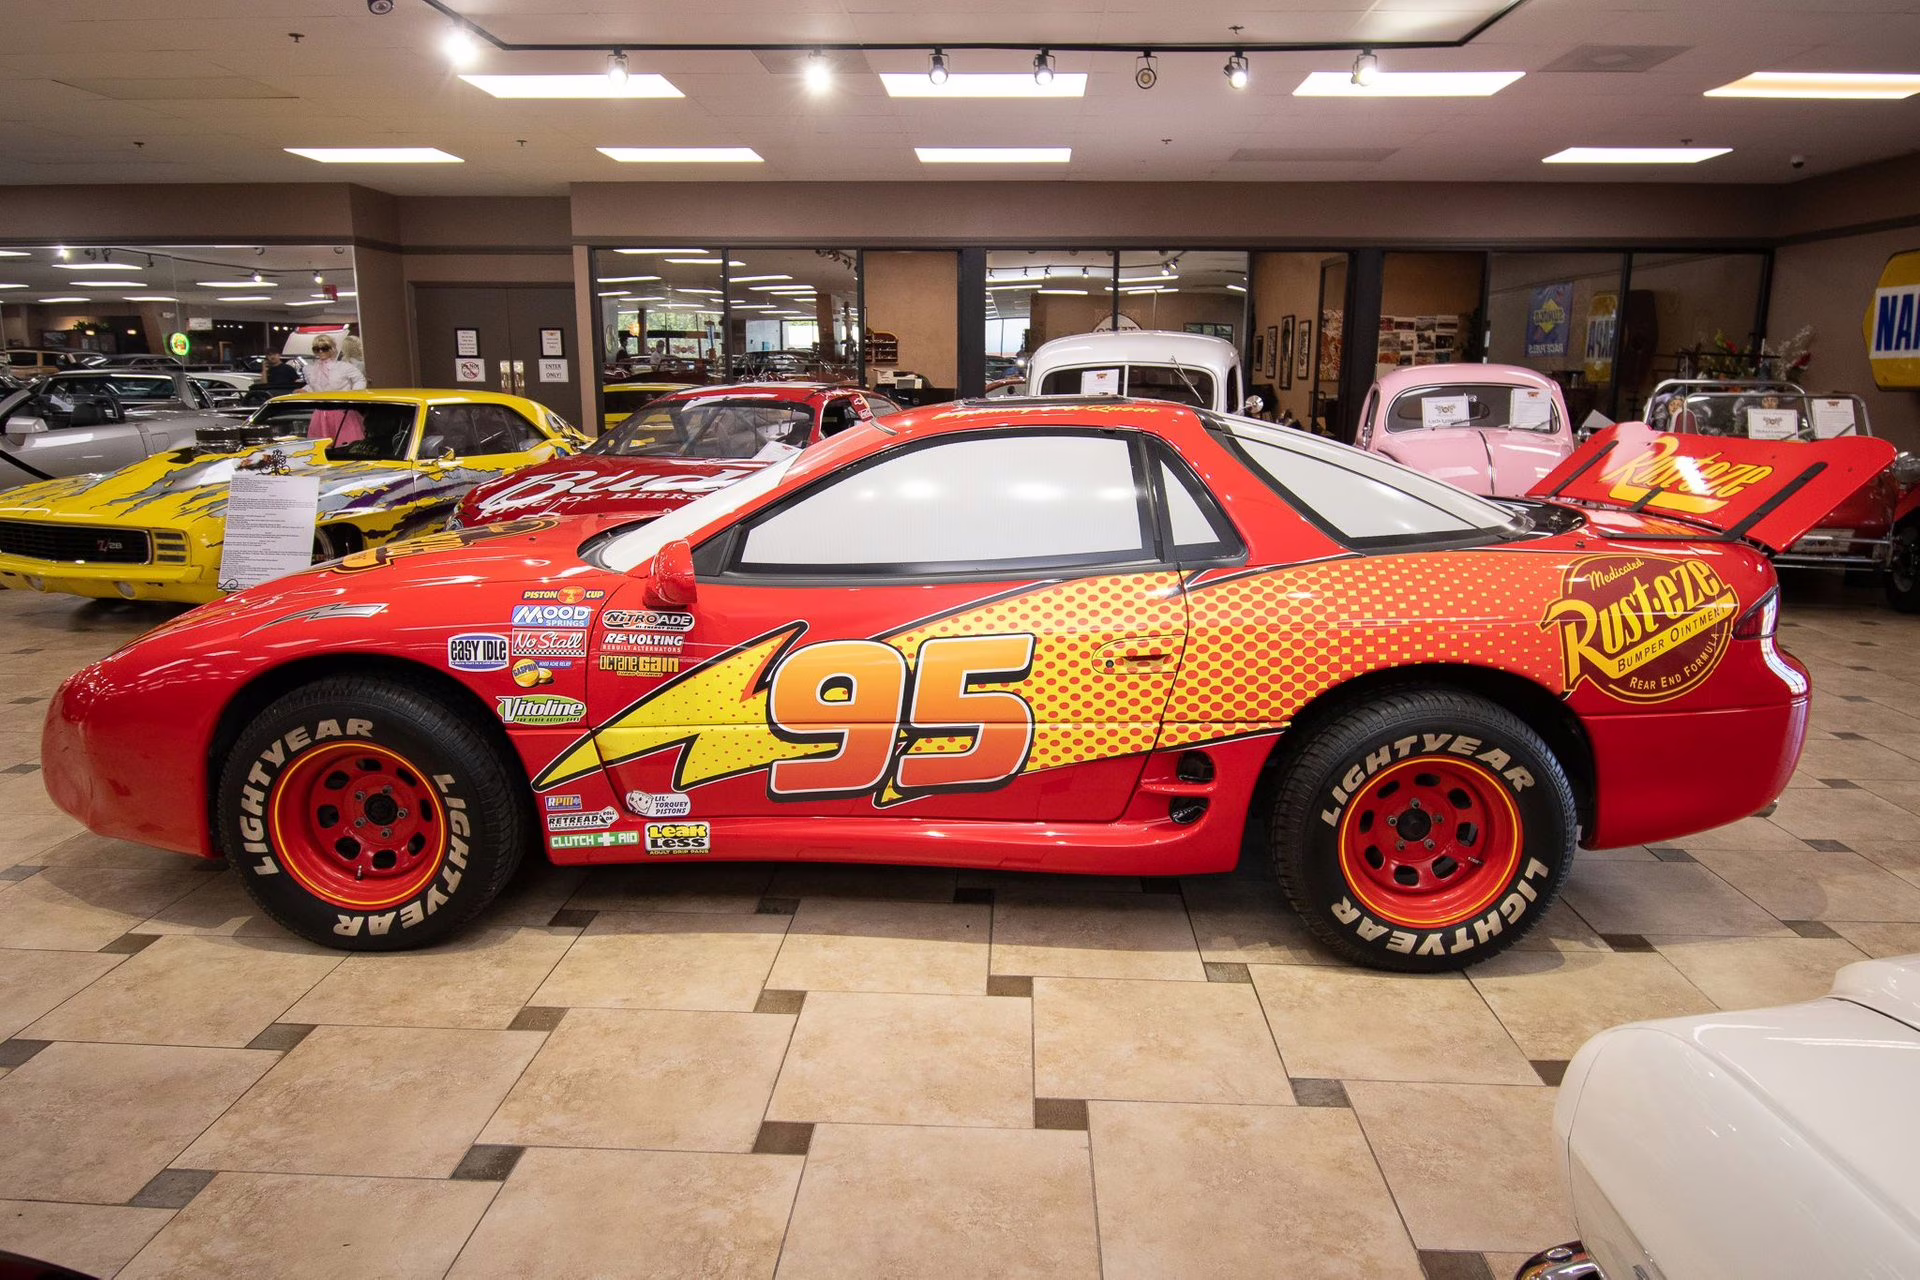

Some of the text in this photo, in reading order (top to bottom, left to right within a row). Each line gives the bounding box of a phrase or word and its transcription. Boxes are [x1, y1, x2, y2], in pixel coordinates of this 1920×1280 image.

[560, 494, 602, 502] OF
[1586, 557, 1645, 591] Medicated
[523, 591, 604, 599] PISTON CUP
[514, 606, 590, 623] MOOD
[513, 631, 583, 649] No Stall
[633, 645, 681, 653] ALTERNATORS
[1629, 676, 1657, 690] REAR
[1661, 674, 1682, 688] END
[502, 698, 584, 722] Vitoline
[766, 633, 1037, 803] 95
[1321, 733, 1536, 828] LIGHTYEAR
[239, 718, 375, 876] LIGHTYEAR
[655, 801, 689, 809] TORQUEY
[549, 815, 599, 825] RETREAD
[551, 832, 638, 848] CLUTCH AID
[332, 773, 472, 938] LIGHTYEAR
[1331, 857, 1549, 957] LIGHTYEAR
